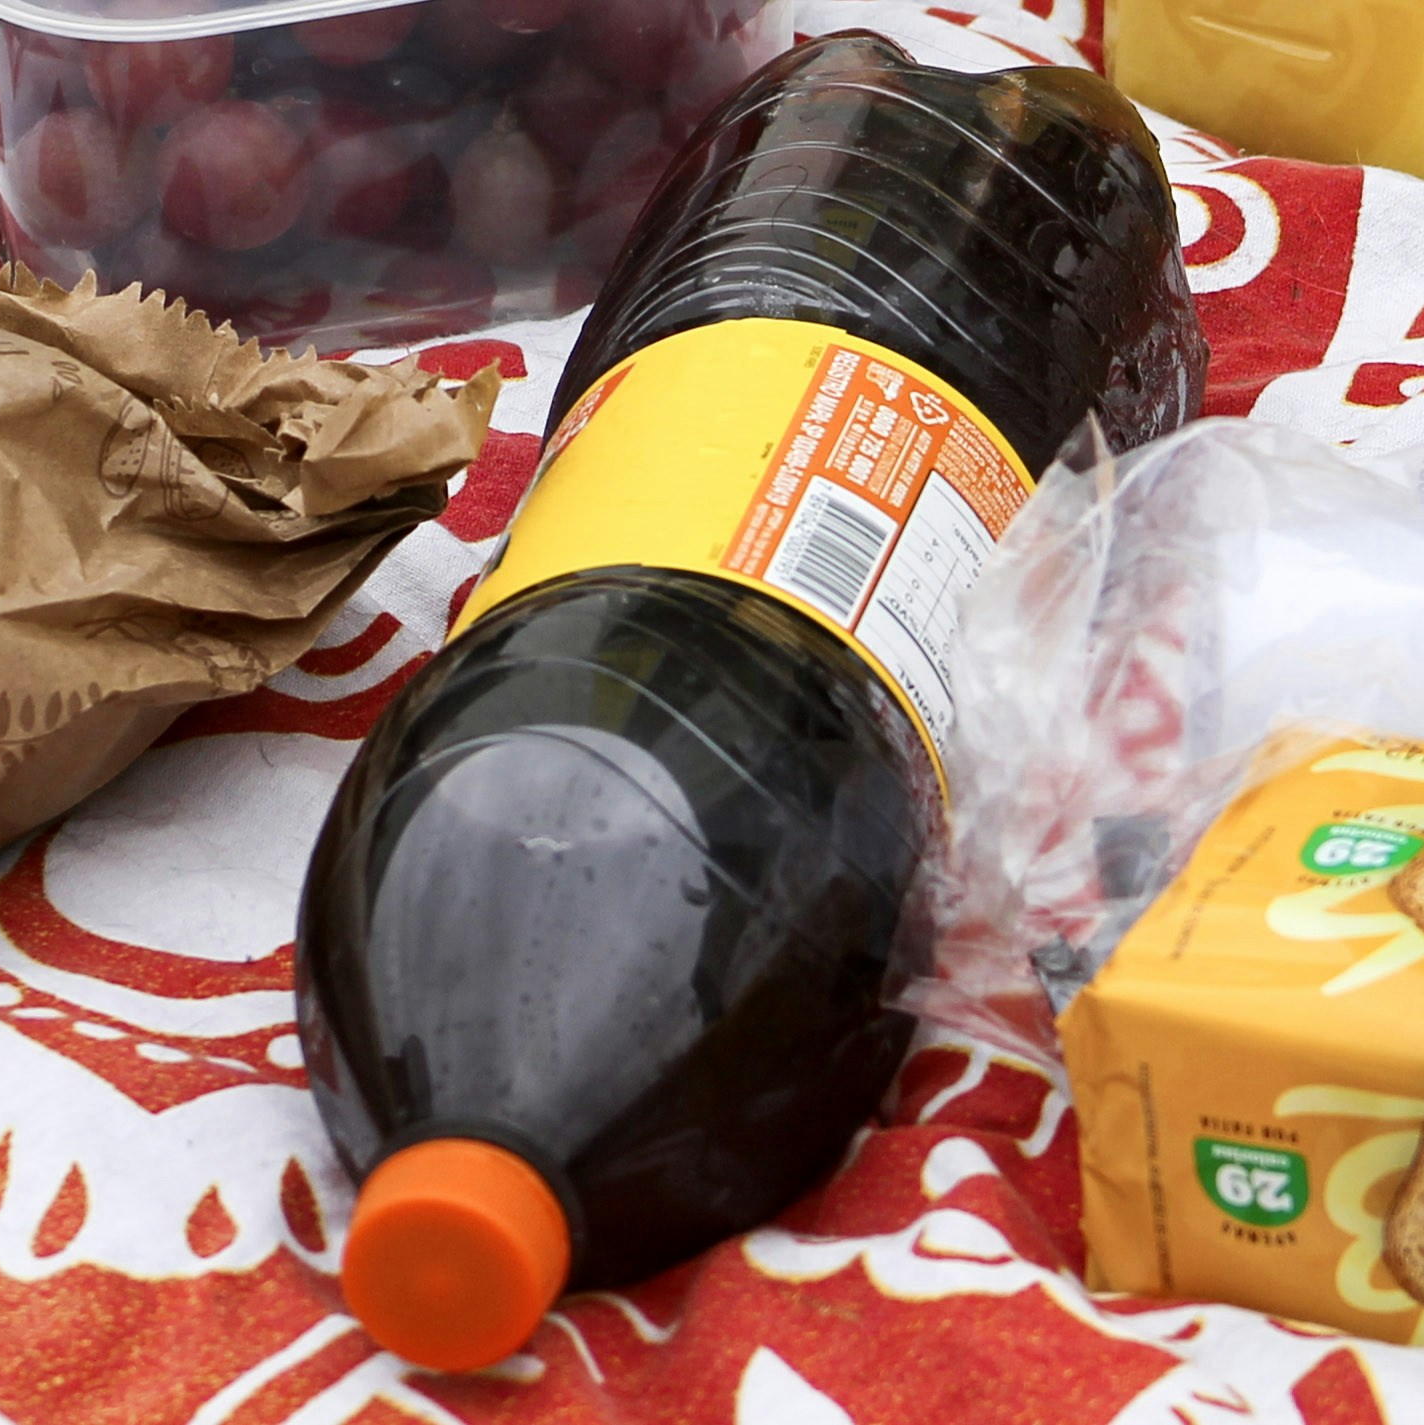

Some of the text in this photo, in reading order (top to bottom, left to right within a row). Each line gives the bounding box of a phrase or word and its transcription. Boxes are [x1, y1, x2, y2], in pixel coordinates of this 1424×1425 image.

[820, 350, 859, 397] REGISTRO
[848, 405, 897, 484] 0800 725 0001
[1314, 835, 1396, 869] 29
[1214, 1167, 1295, 1215] 29
